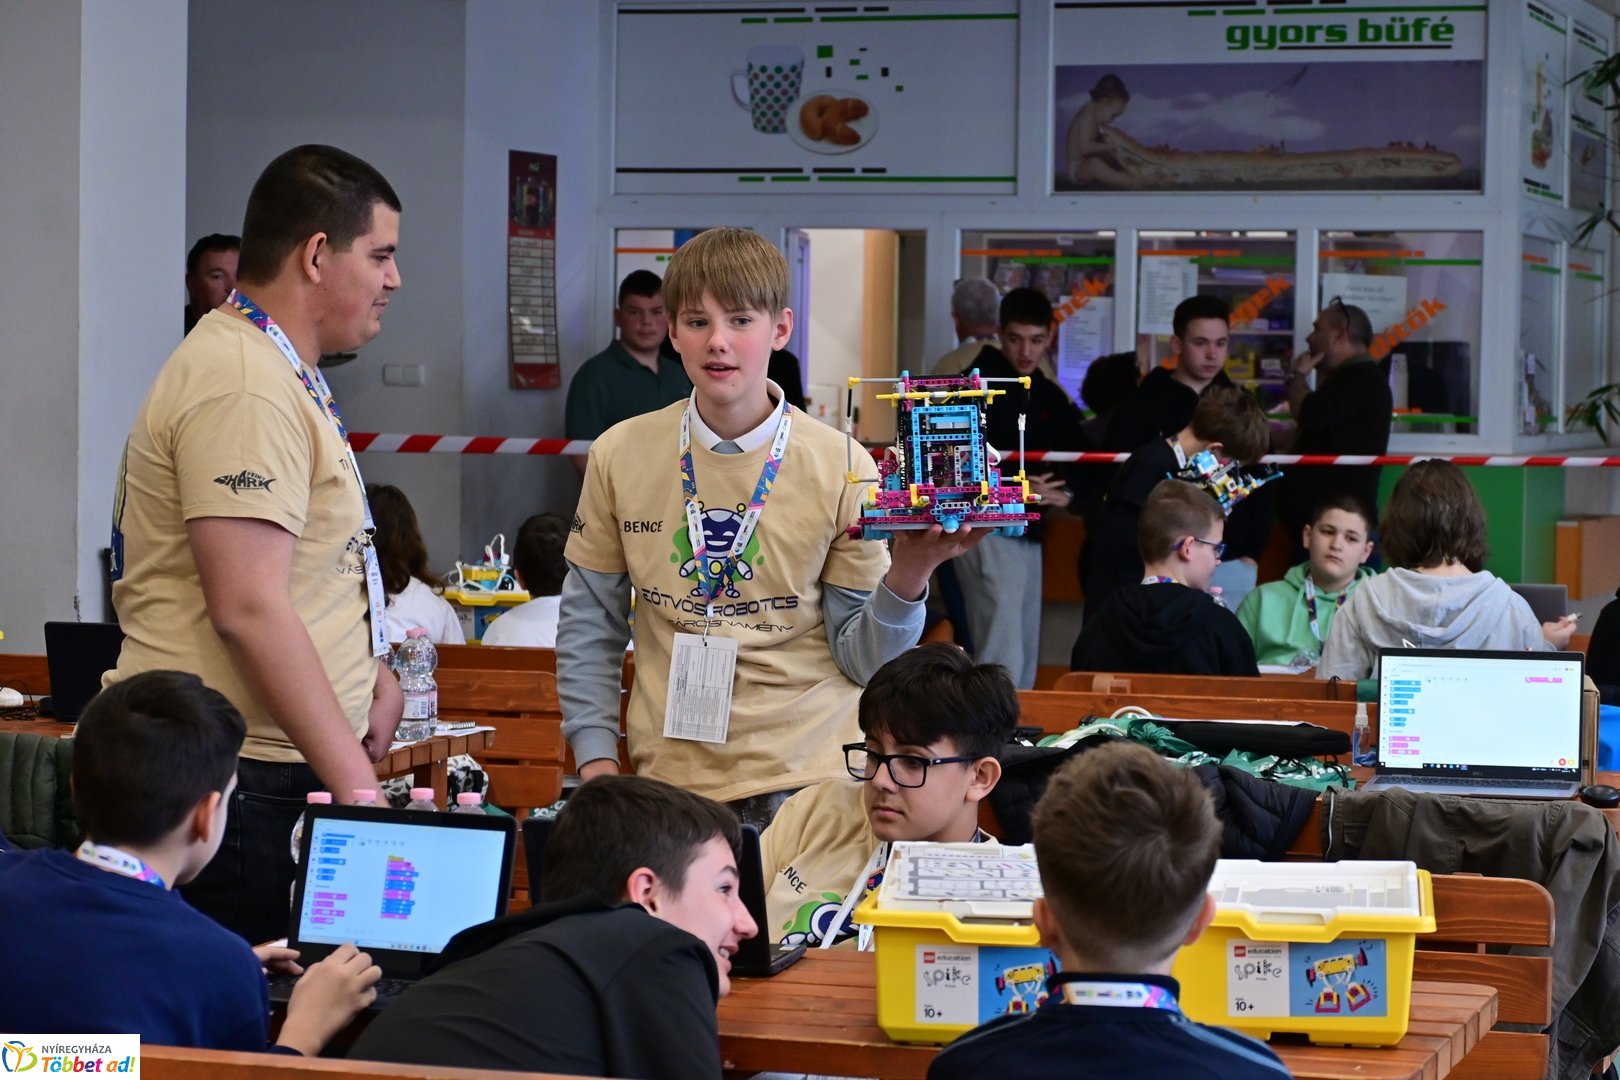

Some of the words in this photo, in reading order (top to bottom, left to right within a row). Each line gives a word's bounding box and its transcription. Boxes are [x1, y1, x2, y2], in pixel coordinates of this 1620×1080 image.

[1226, 25, 1348, 50] gyors
[1358, 16, 1455, 42] büfé
[213, 470, 277, 495] SHARK
[623, 520, 664, 534] BENCE
[641, 586, 707, 616] EÖTVÖS
[712, 595, 799, 617] ROBOTICS
[779, 865, 808, 895] NCE
[923, 966, 972, 987] spike
[1234, 959, 1282, 981] spike
